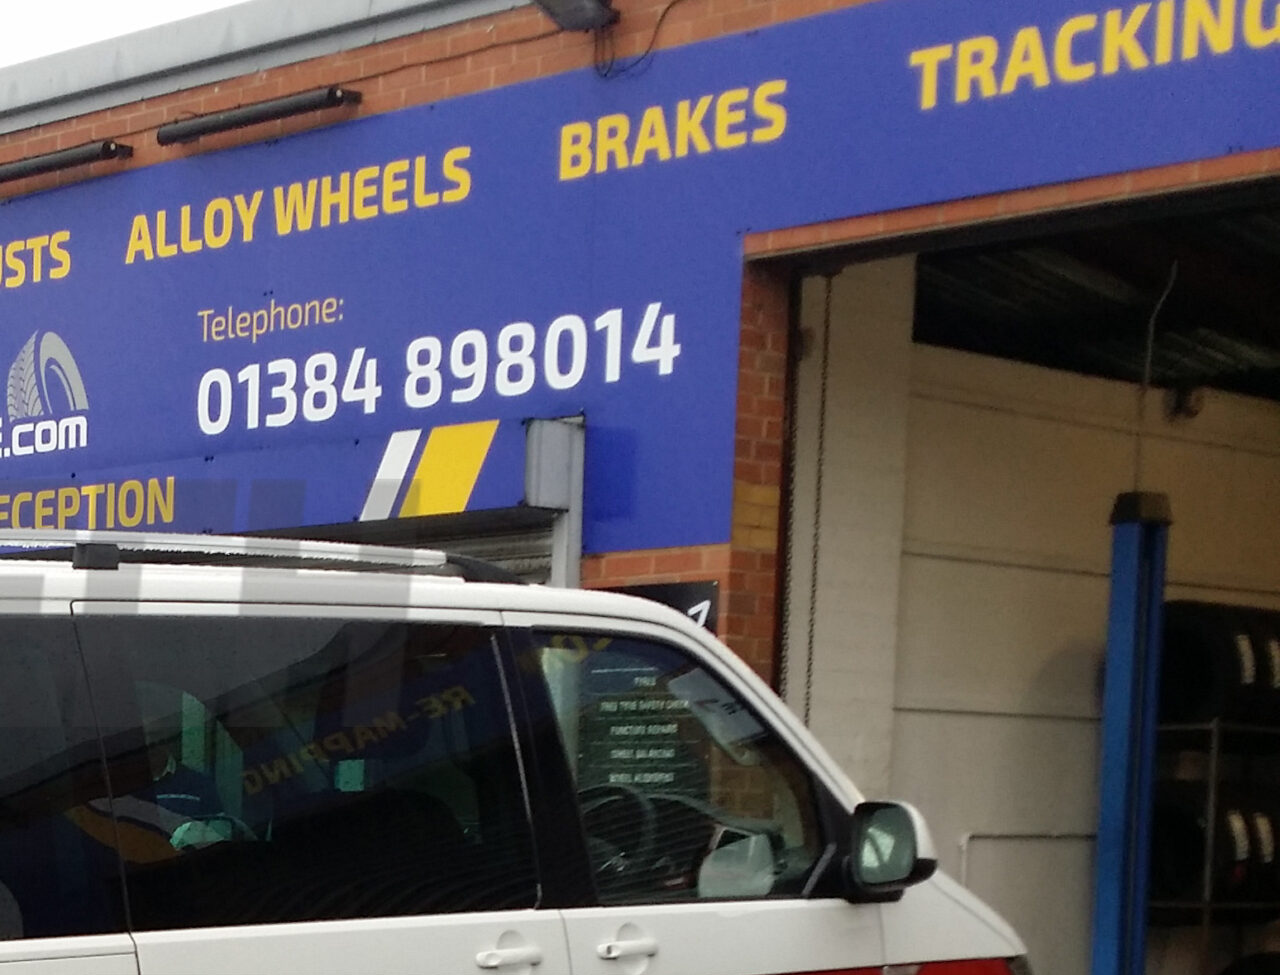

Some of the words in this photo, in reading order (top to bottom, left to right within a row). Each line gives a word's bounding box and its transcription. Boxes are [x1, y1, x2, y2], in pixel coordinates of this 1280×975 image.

[559, 79, 788, 182] BRAKES
[125, 189, 263, 265] ALLOY
[272, 145, 472, 235] WHEELS
[197, 296, 344, 344] Telephone:
[197, 347, 382, 436] 01384
[403, 301, 682, 410] 898014
